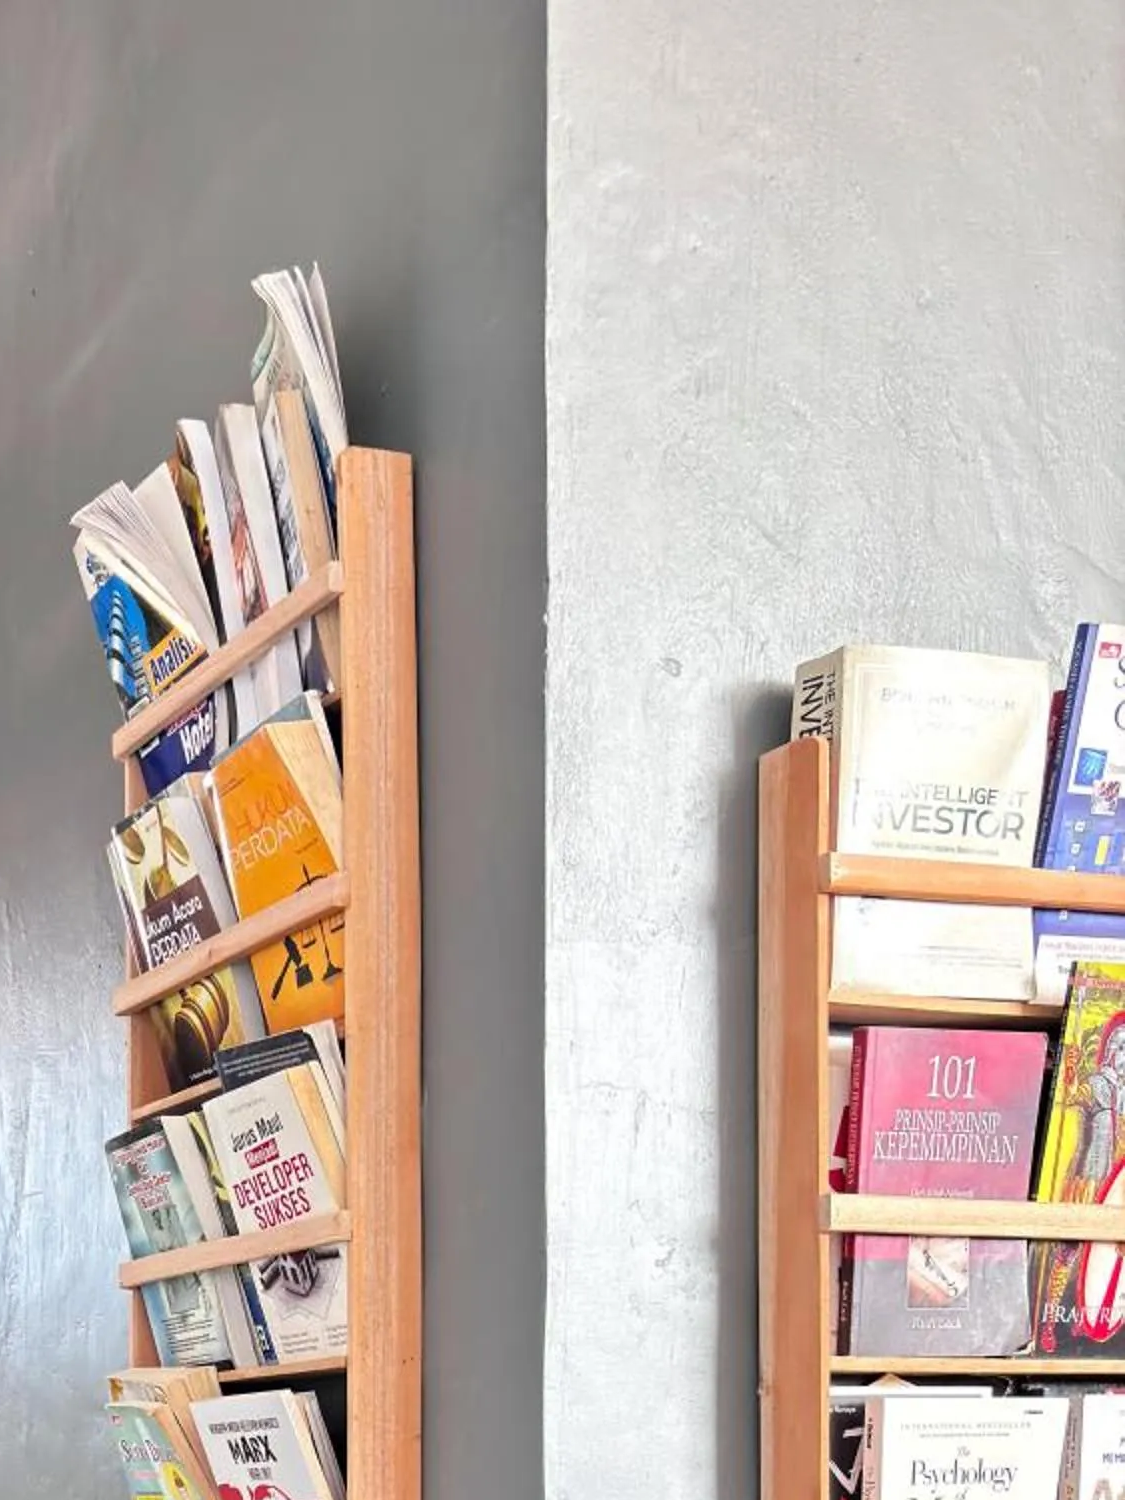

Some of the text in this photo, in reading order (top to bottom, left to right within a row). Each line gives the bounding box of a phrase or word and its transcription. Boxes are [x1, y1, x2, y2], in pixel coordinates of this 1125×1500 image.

[824, 709, 835, 743] INT
[228, 804, 311, 876] PERDATA
[926, 1055, 977, 1100] 101
[894, 1109, 1001, 1133] PRINSIP-PRINSIP
[873, 1131, 1019, 1166] KEPEMIMPINAN
[234, 1154, 315, 1209] DEVELOPER
[253, 1188, 311, 1230] SUKSES
[227, 1435, 278, 1467] MARX
[909, 1458, 1018, 1493] Psychology
